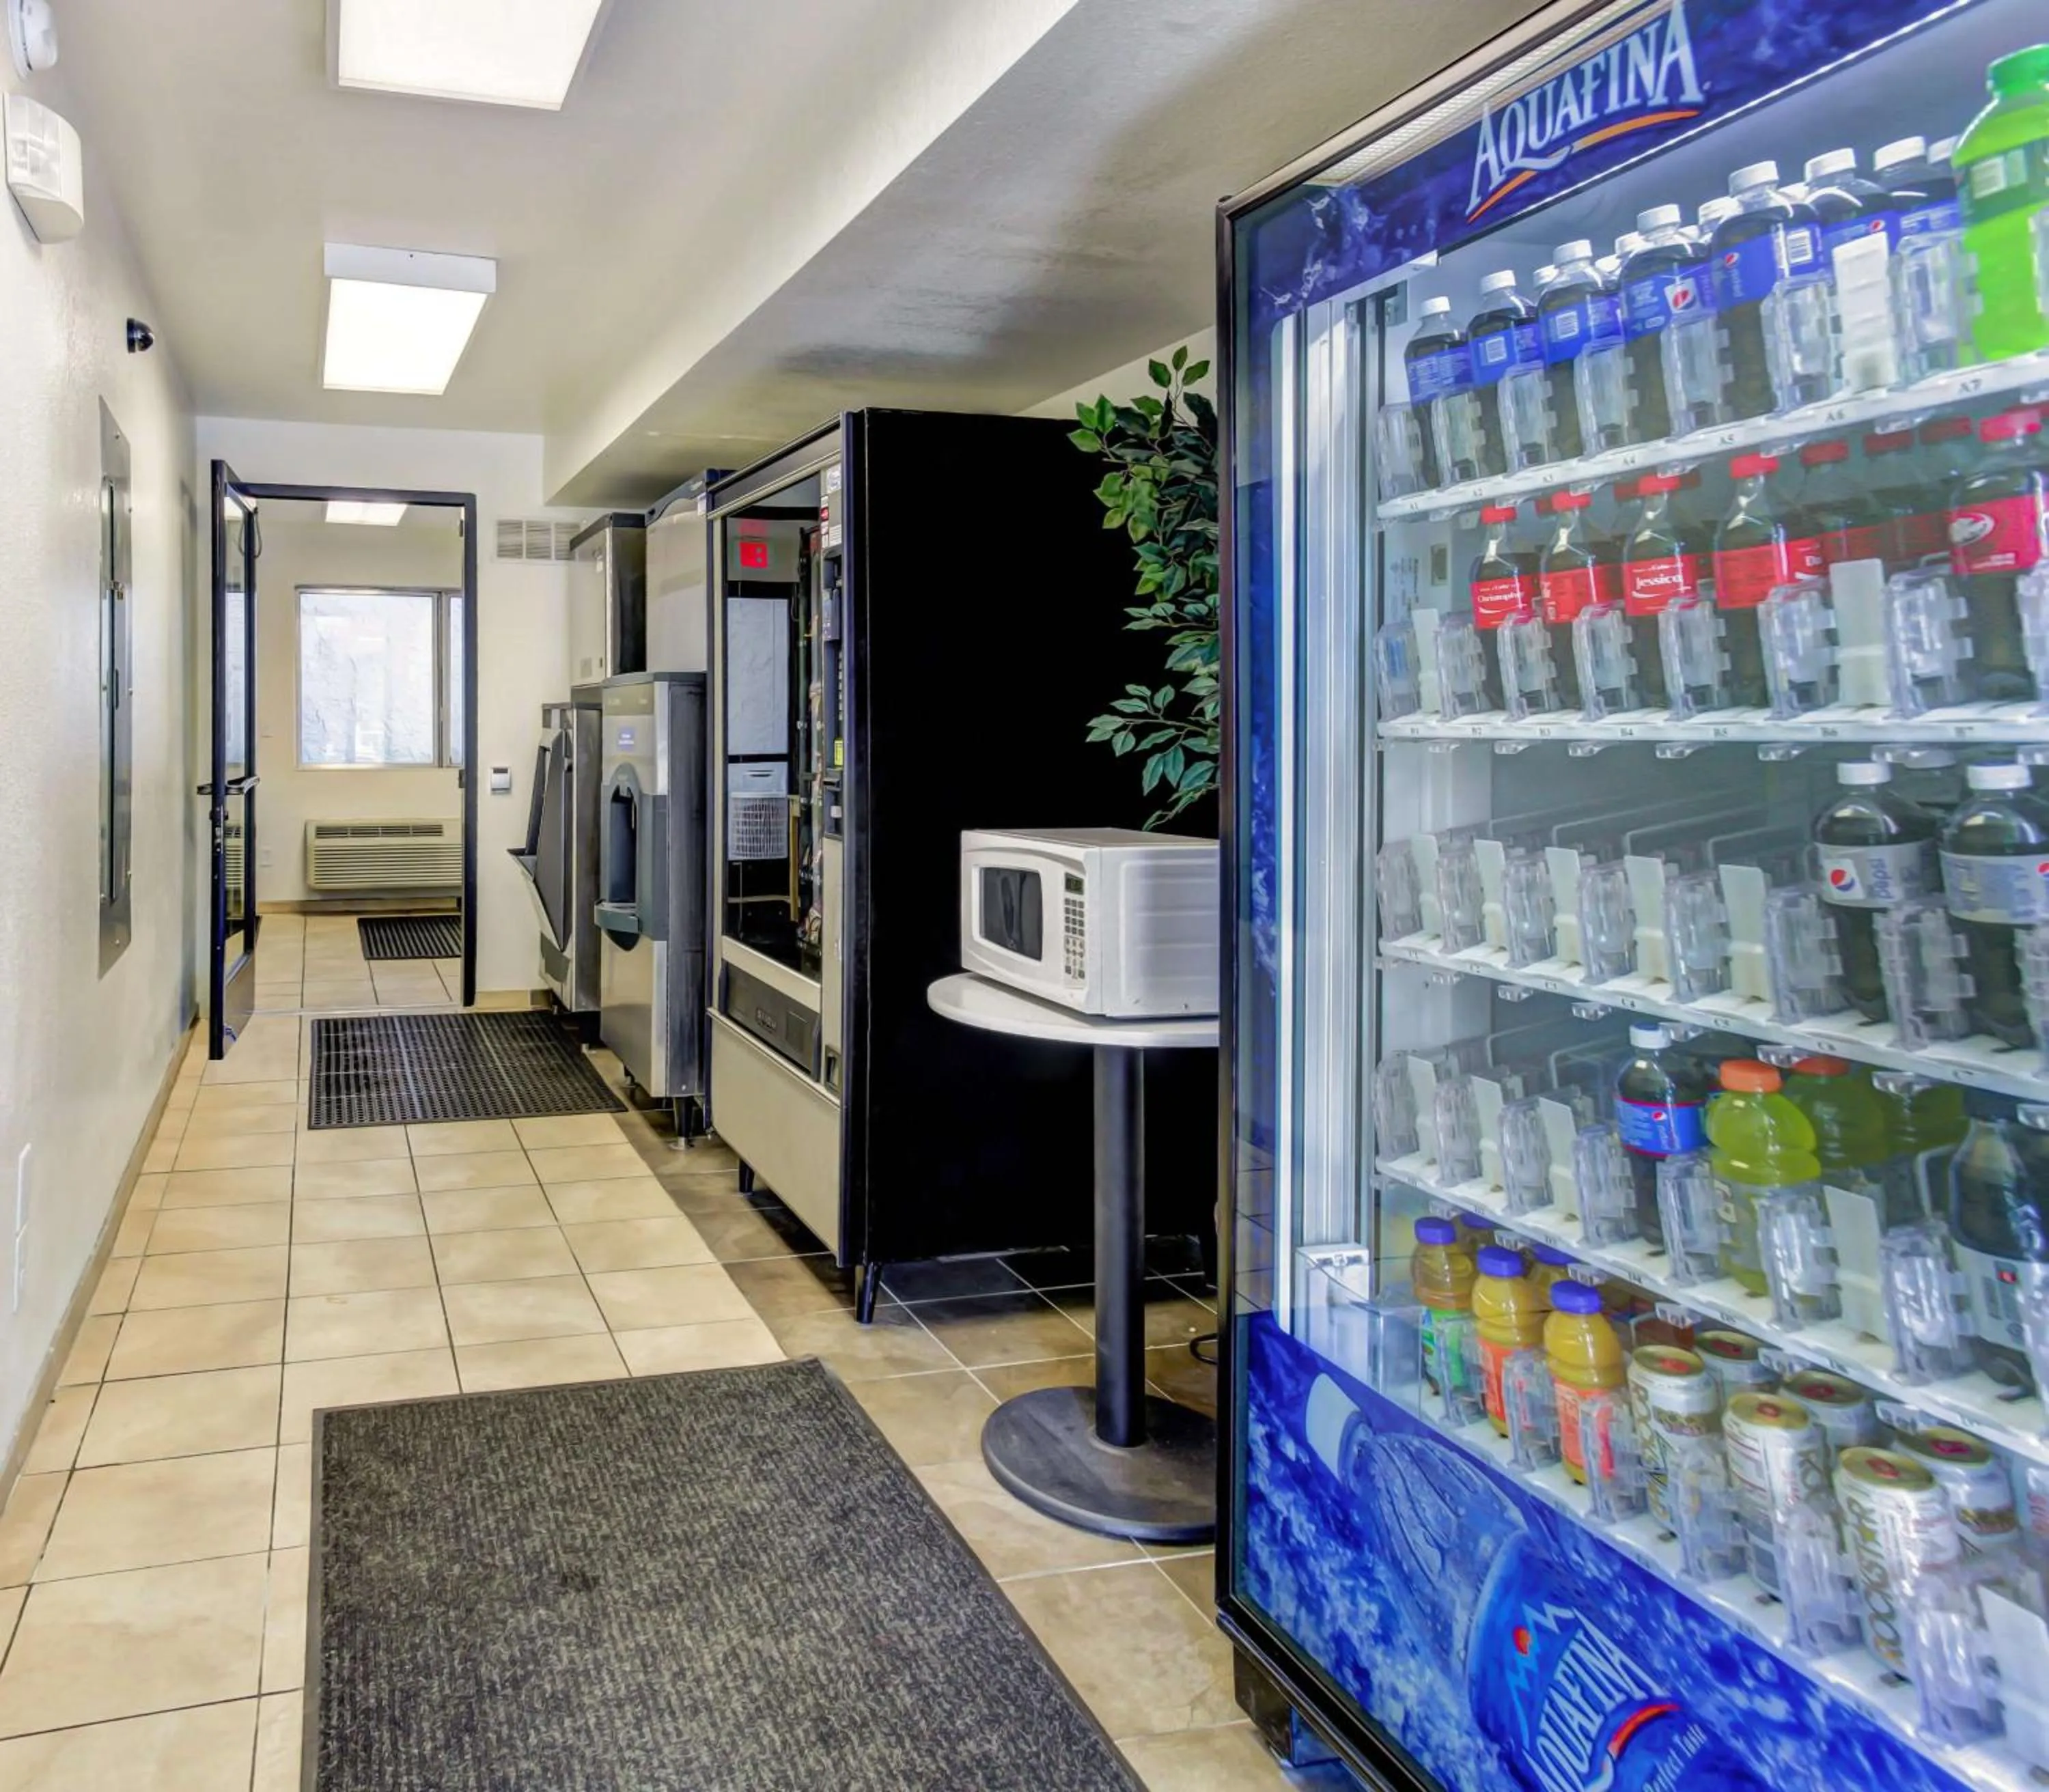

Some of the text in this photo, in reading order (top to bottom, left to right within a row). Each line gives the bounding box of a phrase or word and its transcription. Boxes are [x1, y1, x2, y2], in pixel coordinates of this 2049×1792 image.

[1466, 0, 1705, 215] AQUAFINA
[1957, 378, 1983, 395] A7
[1824, 410, 1845, 422] A6
[1636, 573, 1684, 591] Jessica
[1871, 857, 1897, 901] pepsi
